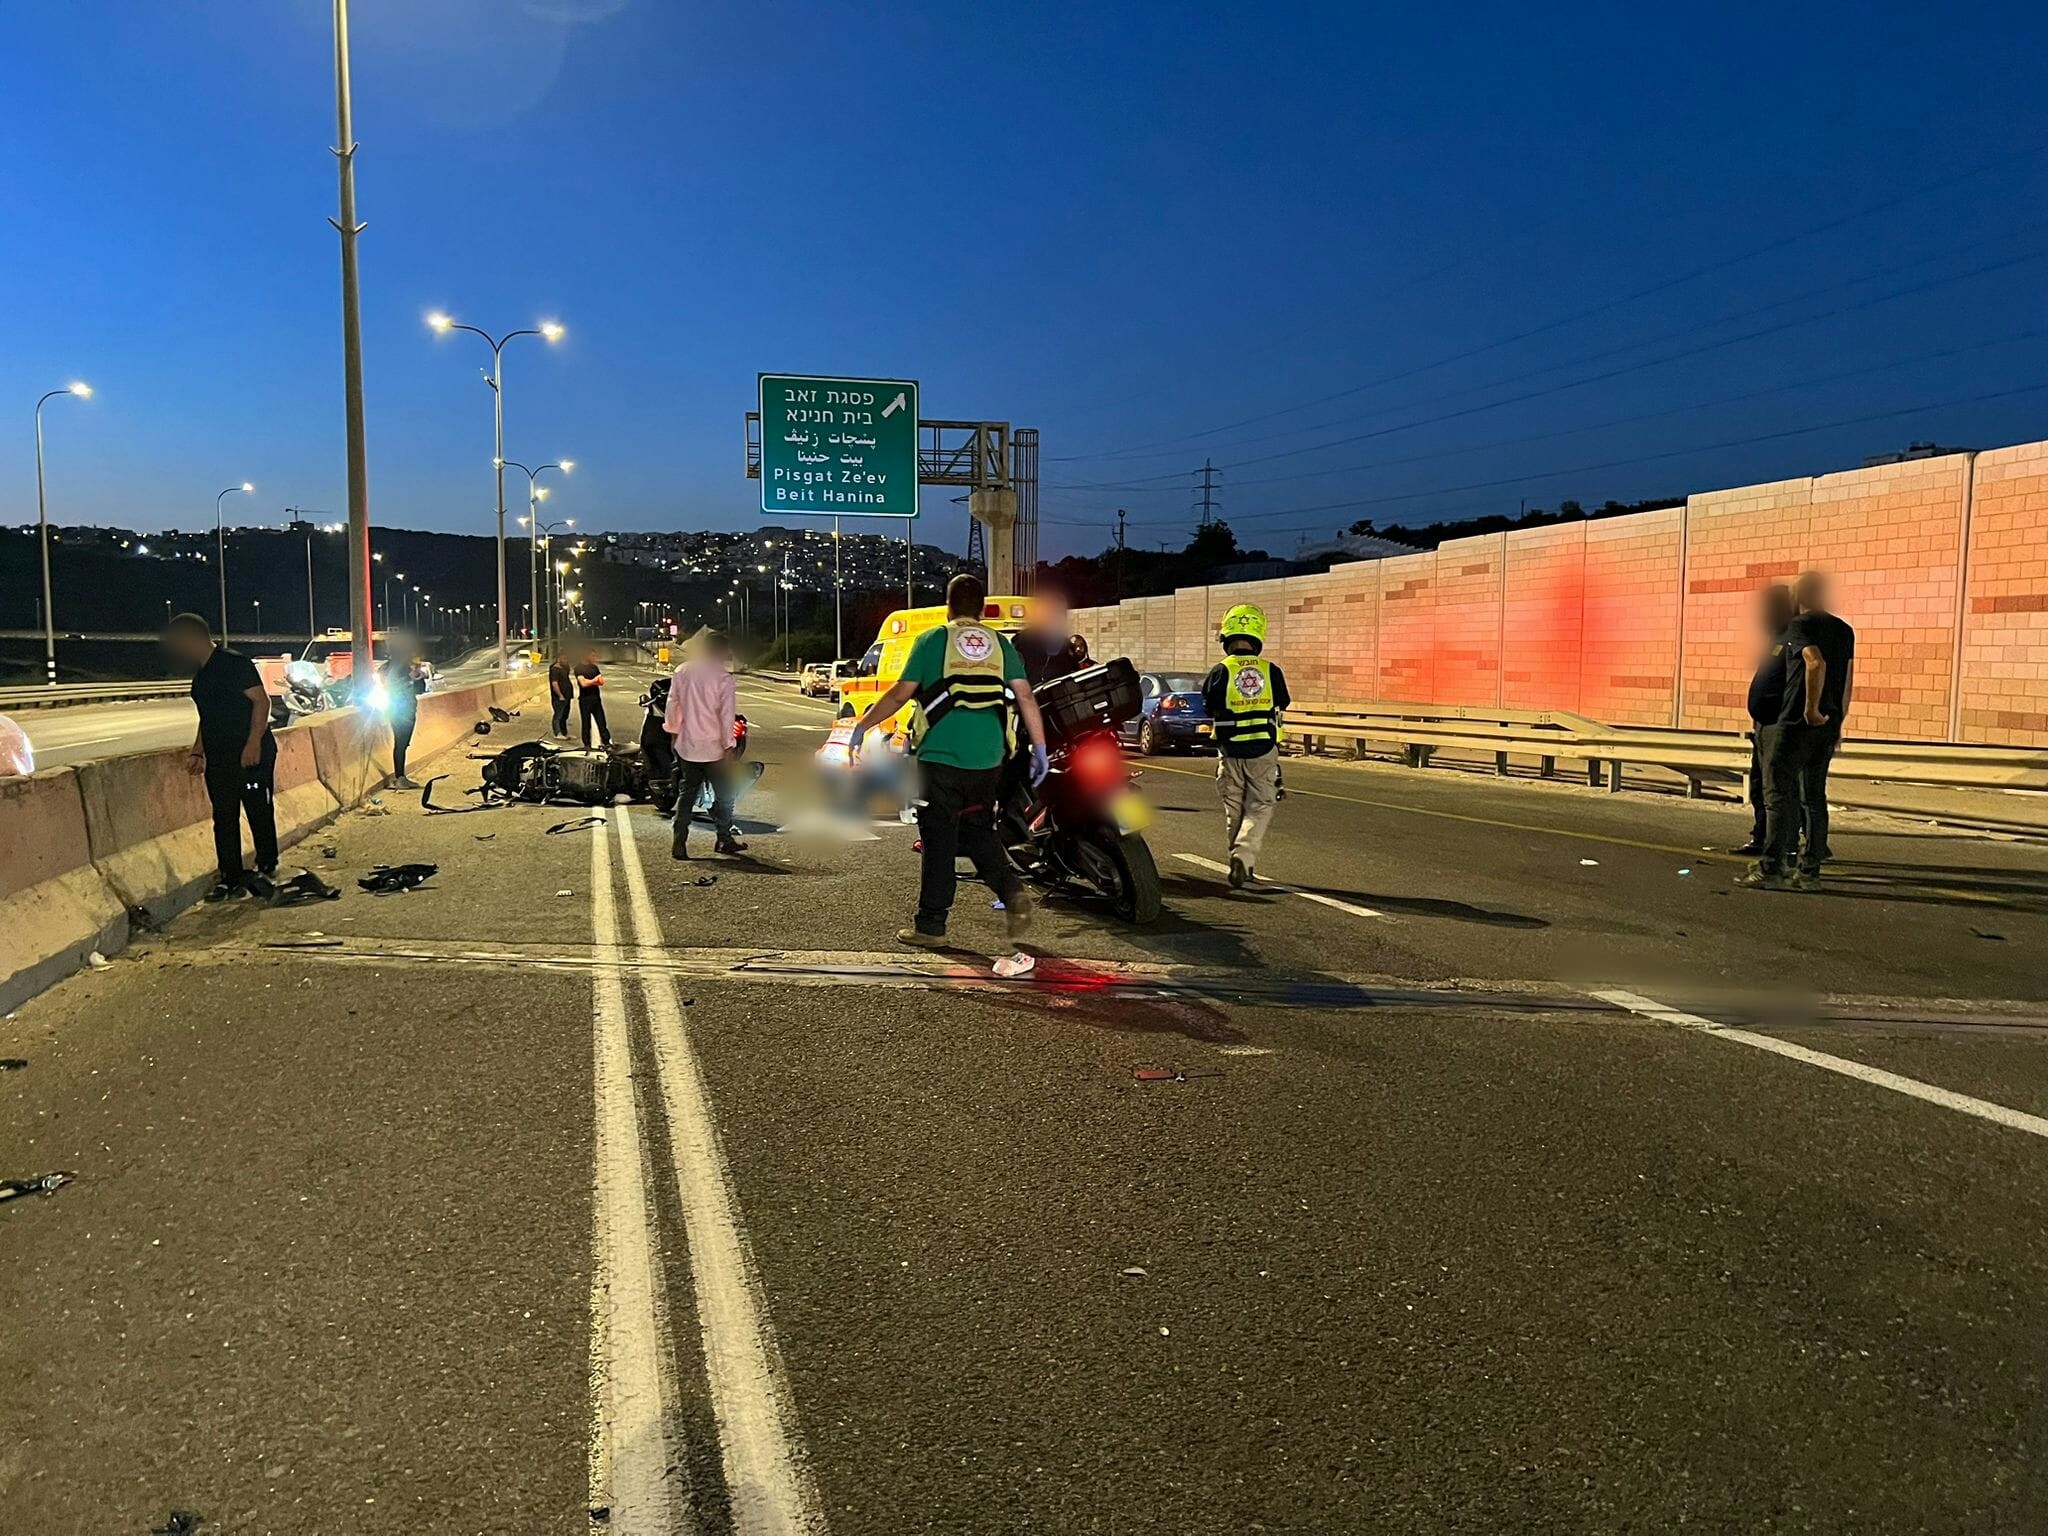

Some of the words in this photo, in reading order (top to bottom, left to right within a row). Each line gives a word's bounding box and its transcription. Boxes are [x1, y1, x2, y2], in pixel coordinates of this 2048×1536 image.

[784, 389, 817, 403] זאב
[826, 391, 875, 405] פסגת
[786, 408, 834, 423] חנינא
[842, 411, 873, 425] בית
[797, 450, 831, 465] حنينا
[839, 453, 864, 468] بيت
[774, 468, 833, 485] Pisgat
[841, 470, 887, 484] Ze'ev
[776, 488, 815, 501] Beit
[823, 489, 885, 504] Hanina
